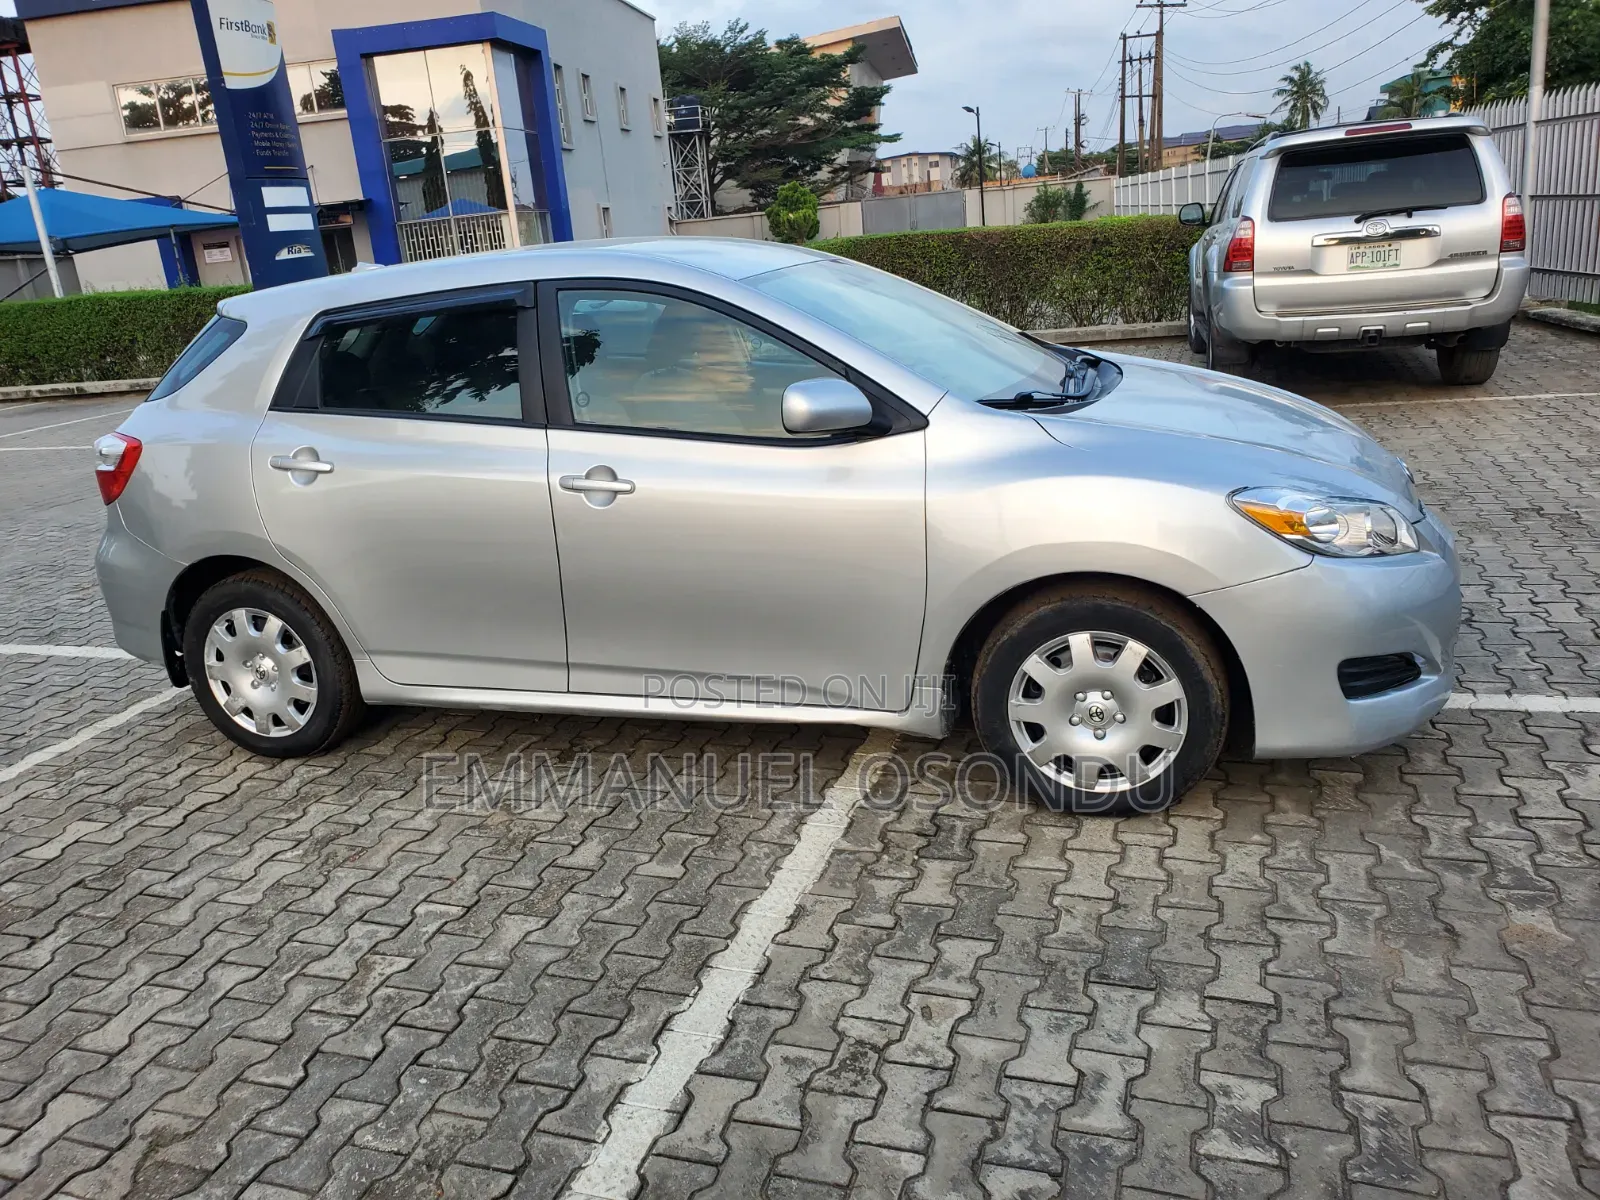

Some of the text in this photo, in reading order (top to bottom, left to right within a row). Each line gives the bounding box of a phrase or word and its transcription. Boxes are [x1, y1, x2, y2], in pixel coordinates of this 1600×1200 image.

[219, 17, 267, 36] FirstBank
[250, 121, 264, 129] 24/7
[288, 246, 302, 255] Ria
